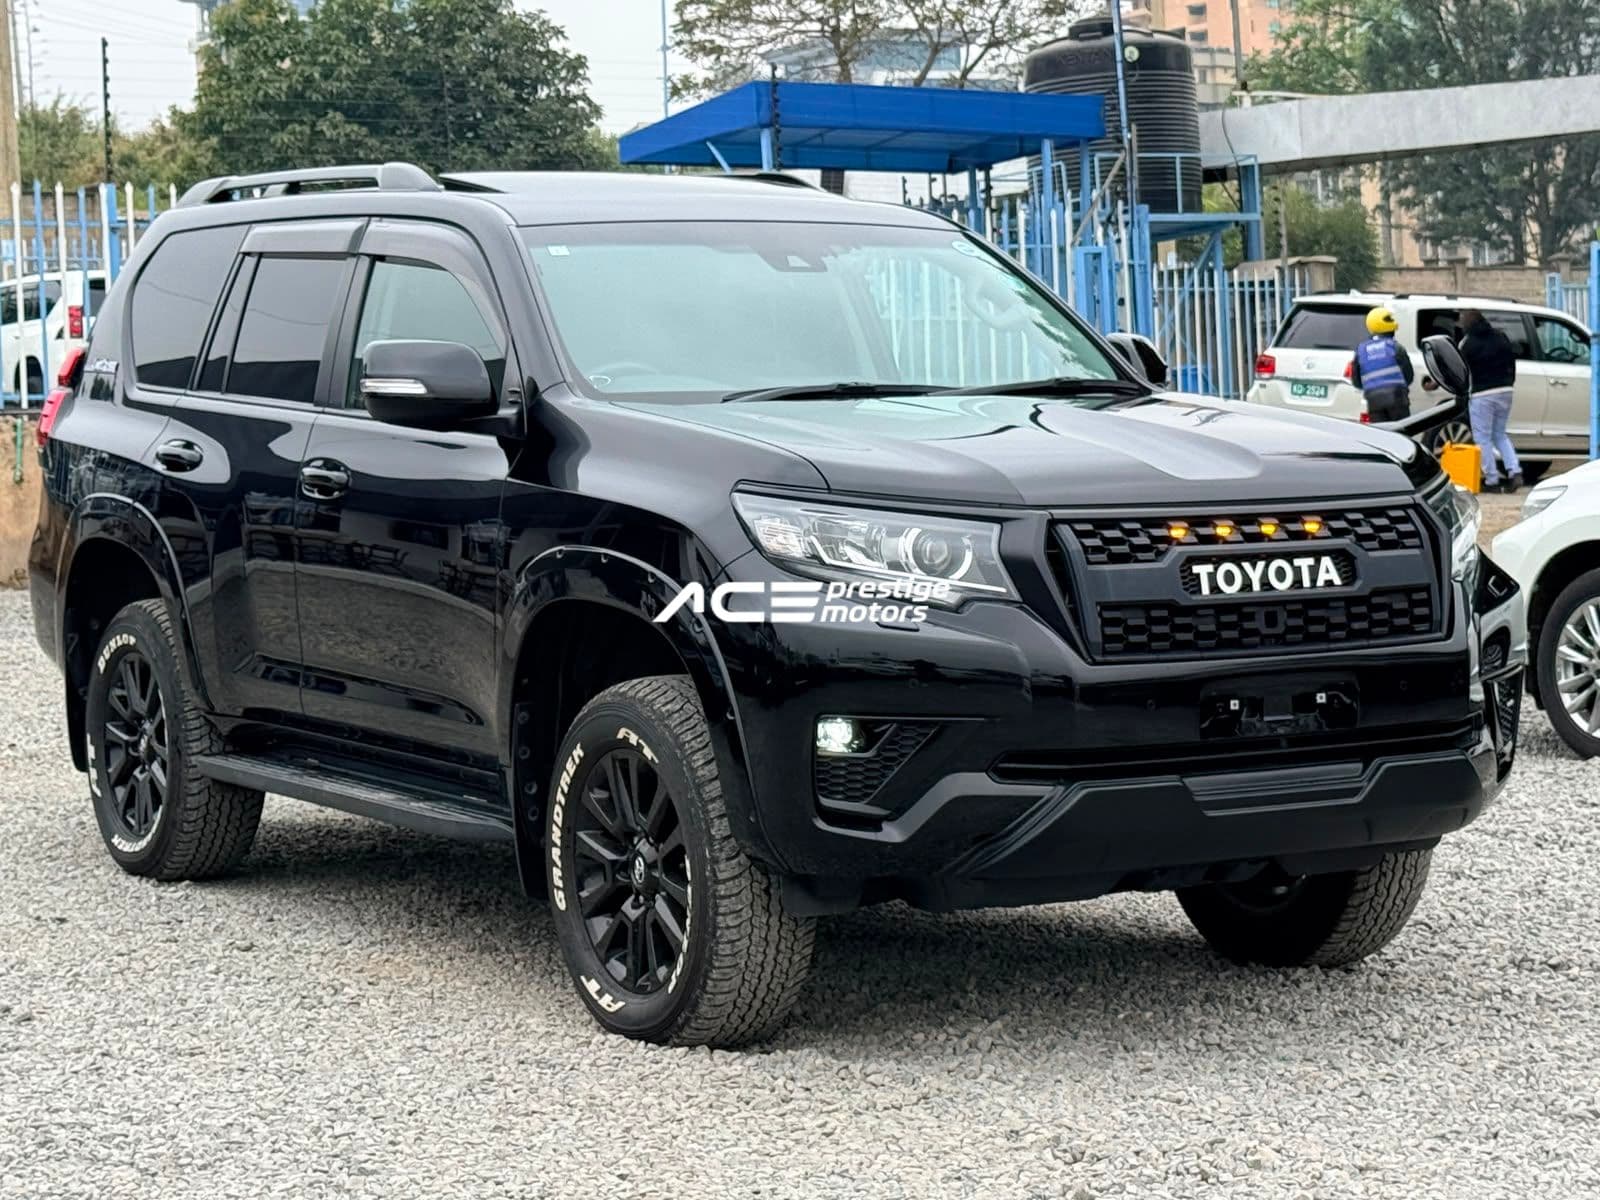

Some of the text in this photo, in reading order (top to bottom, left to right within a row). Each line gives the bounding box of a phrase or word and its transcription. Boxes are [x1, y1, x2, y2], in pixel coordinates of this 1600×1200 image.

[1192, 556, 1342, 595] TOYOTA
[97, 633, 137, 675] DUNLOP
[617, 727, 659, 764] AT
[551, 742, 585, 912] GRANDTREK
